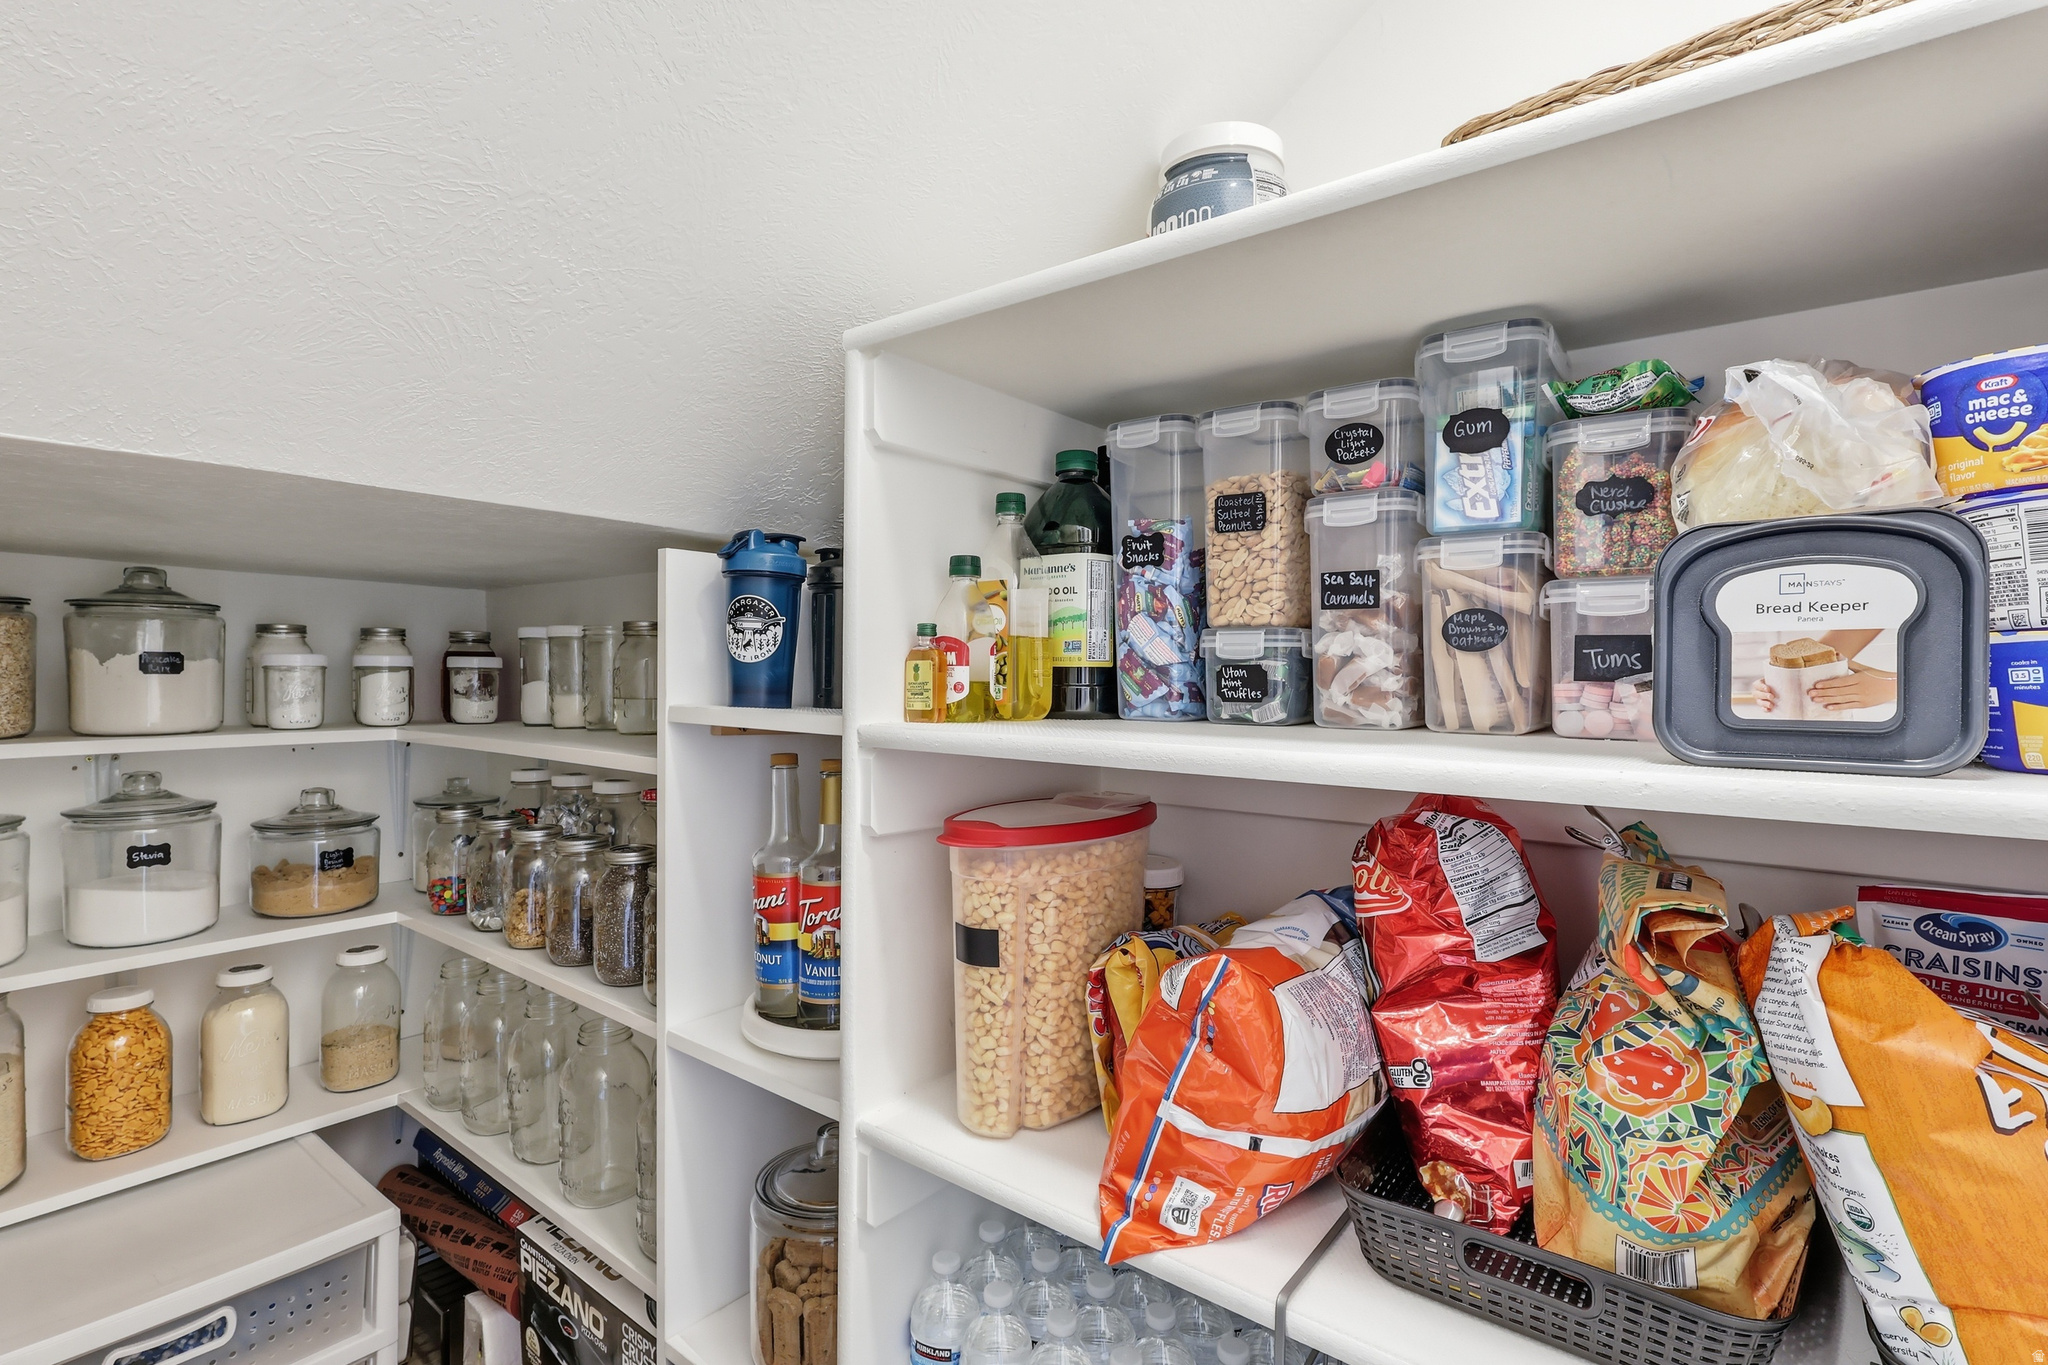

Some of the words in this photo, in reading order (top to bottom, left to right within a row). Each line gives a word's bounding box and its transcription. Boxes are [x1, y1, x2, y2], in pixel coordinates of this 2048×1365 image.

[1985, 378, 2008, 389] Kraft
[1968, 394, 2010, 411] mac
[2012, 389, 2028, 403] &
[1334, 428, 1373, 441] Crystal
[1454, 420, 1492, 438] Gum
[1341, 440, 1365, 451] Light
[1336, 447, 1376, 461] Packets
[1501, 440, 1513, 470] PEPPERM
[1948, 456, 1984, 471] original
[1950, 471, 1976, 482] flavor
[1590, 485, 1634, 499] Nerd
[1218, 496, 1254, 507] Roasted
[1217, 509, 1250, 520] Salted
[1218, 520, 1252, 531] Peanuts
[1127, 539, 1152, 550] Fruit
[1126, 551, 1159, 563] Snacks
[1023, 563, 1076, 575] Marianne's
[1324, 574, 1344, 585] Sea
[1350, 572, 1376, 587] Salt
[1788, 579, 1842, 588] MAINSTAYS
[1062, 587, 1078, 595] OIL
[1324, 592, 1374, 606] Caramels
[729, 598, 776, 617] STARGAZER
[1756, 602, 1801, 614] Bread
[1808, 601, 1869, 614] Keeper
[1453, 613, 1486, 624] Maple
[729, 647, 746, 660] CAST
[751, 648, 772, 661] IRON
[1582, 648, 1642, 670] Tums
[1221, 679, 1242, 688] Mint
[1221, 688, 1261, 699] Truffles
[132, 851, 164, 862] Stevia
[1621, 864, 1650, 911] RGANIC
[752, 886, 788, 911] rani
[800, 897, 841, 934] Tora
[1883, 919, 1909, 927] FARMER
[1920, 920, 1957, 943] Ocean
[1958, 931, 1995, 946] Spray
[2016, 938, 2044, 946] OWNED
[1789, 938, 1811, 948] from
[1791, 947, 1804, 955] We
[754, 955, 783, 966] CONUT
[804, 963, 841, 977] VANILL
[1920, 978, 1951, 992] OLE
[1958, 985, 1970, 995] &
[1975, 987, 2030, 1006] JUICY
[1941, 994, 2003, 1010] CRANBERRIES
[1390, 1068, 1413, 1076] GLUTEN
[1752, 1108, 1772, 1132] BLEND
[433, 1147, 456, 1171] Reynolds
[452, 1162, 468, 1181] Wrap
[1234, 1187, 1246, 1197] GO
[1229, 1197, 1241, 1208] TO
[563, 1252, 579, 1265] OVEN
[521, 1248, 604, 1340] PIEZANO
[622, 1322, 656, 1359] CRISPY
[1879, 1333, 1909, 1343] nserve
[916, 1343, 950, 1357] KIRKLAND
[1889, 1347, 1920, 1362] versity
